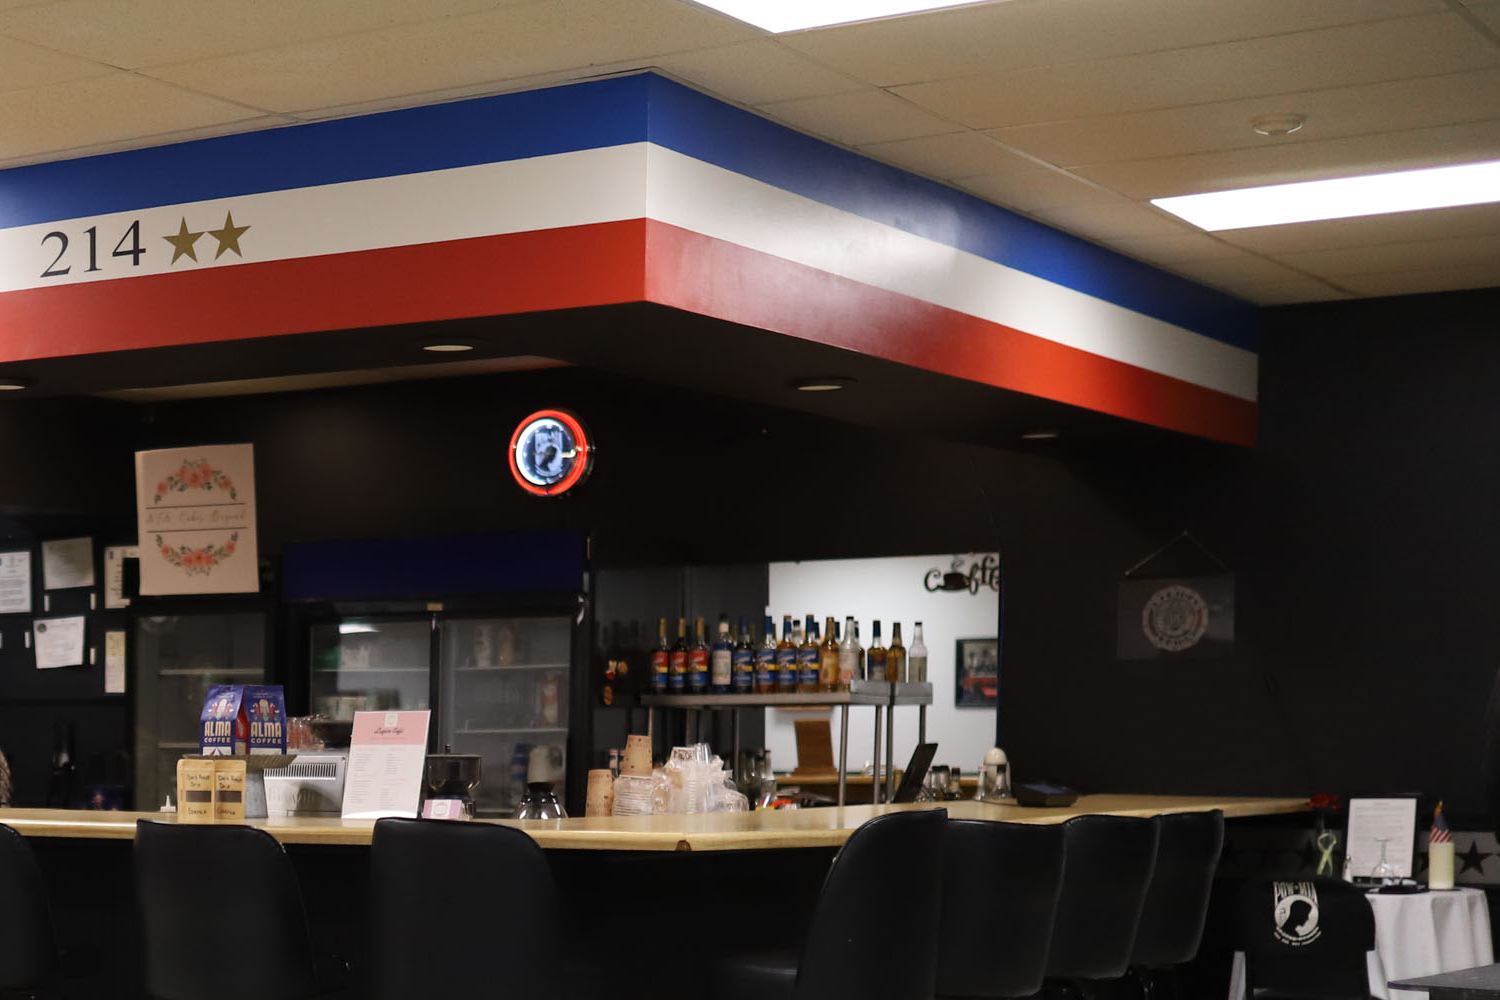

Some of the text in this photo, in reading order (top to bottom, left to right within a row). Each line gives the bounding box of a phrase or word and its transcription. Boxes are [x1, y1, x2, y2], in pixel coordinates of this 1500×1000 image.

[39, 220, 146, 279] 214
[203, 721, 232, 737] ALMA
[250, 721, 282, 738] ALMA
[250, 737, 282, 745] COFFEE
